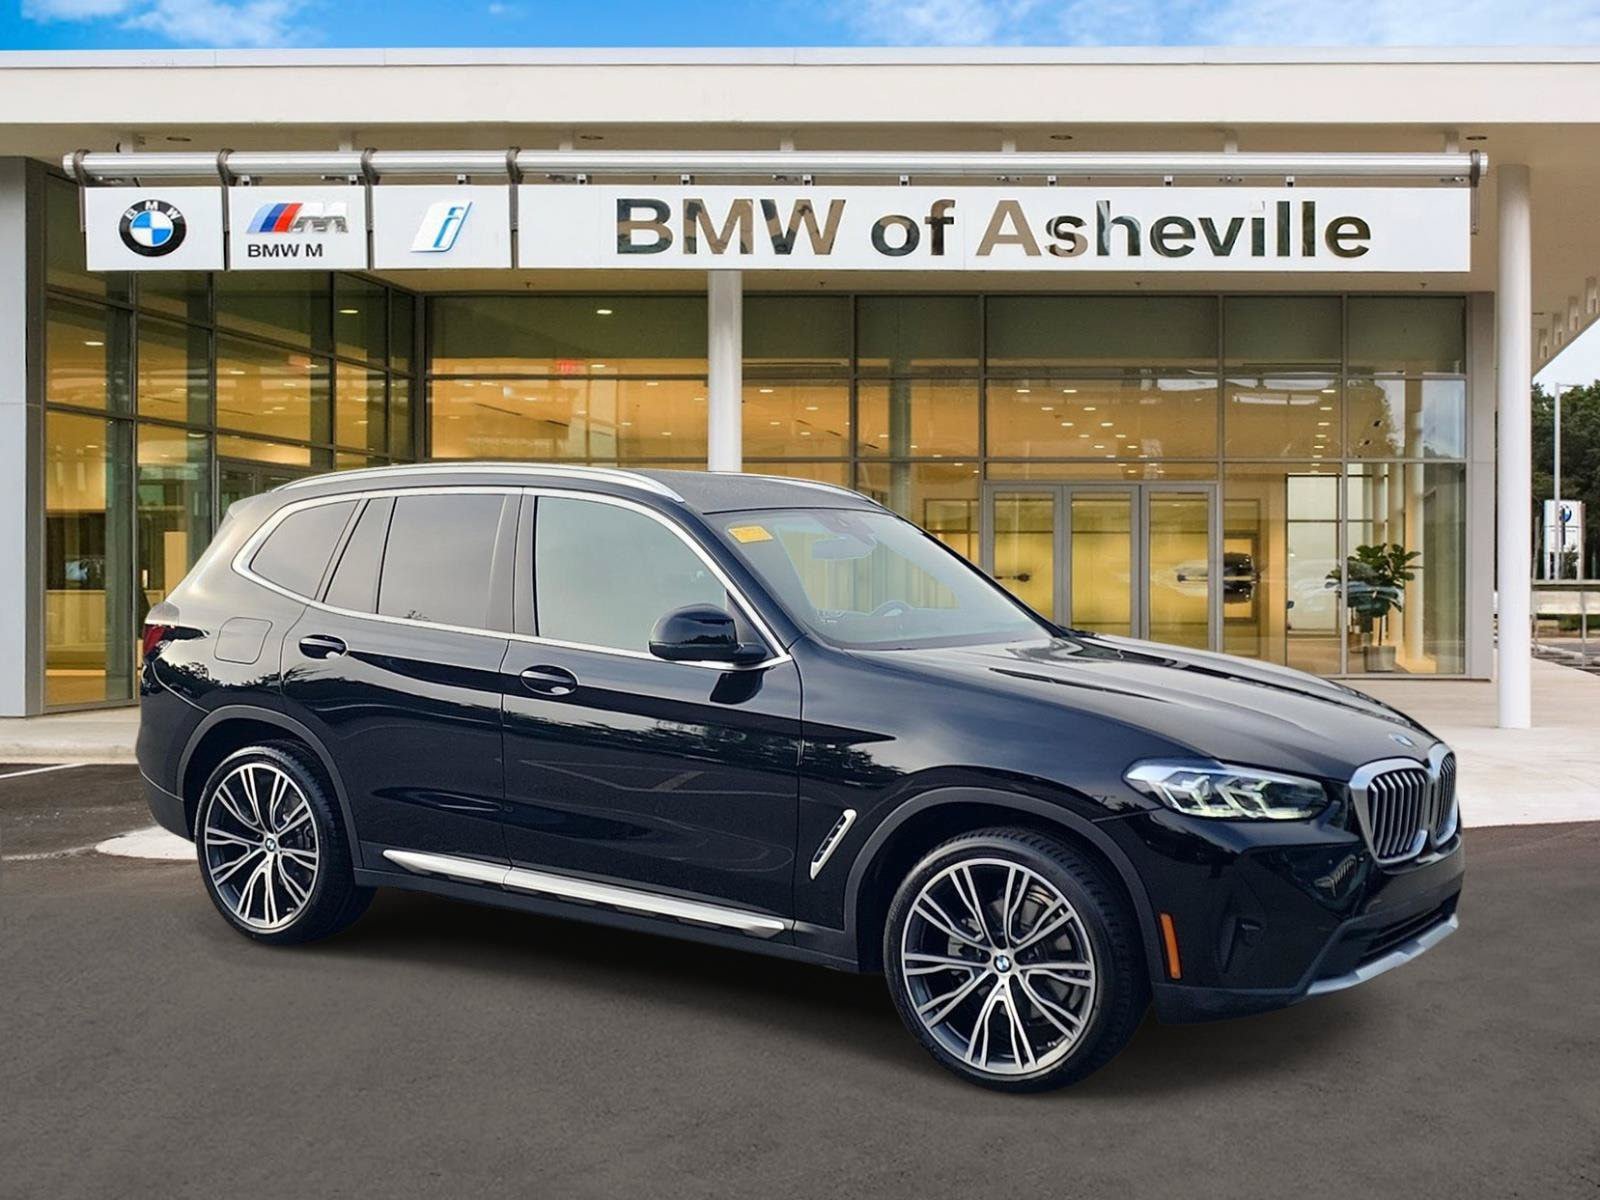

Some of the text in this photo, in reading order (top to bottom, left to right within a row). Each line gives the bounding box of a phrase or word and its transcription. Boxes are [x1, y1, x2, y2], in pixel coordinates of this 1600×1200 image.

[124, 201, 181, 219] BMW
[616, 198, 1372, 258] BMW of Asheville
[248, 244, 323, 257] BMW M
